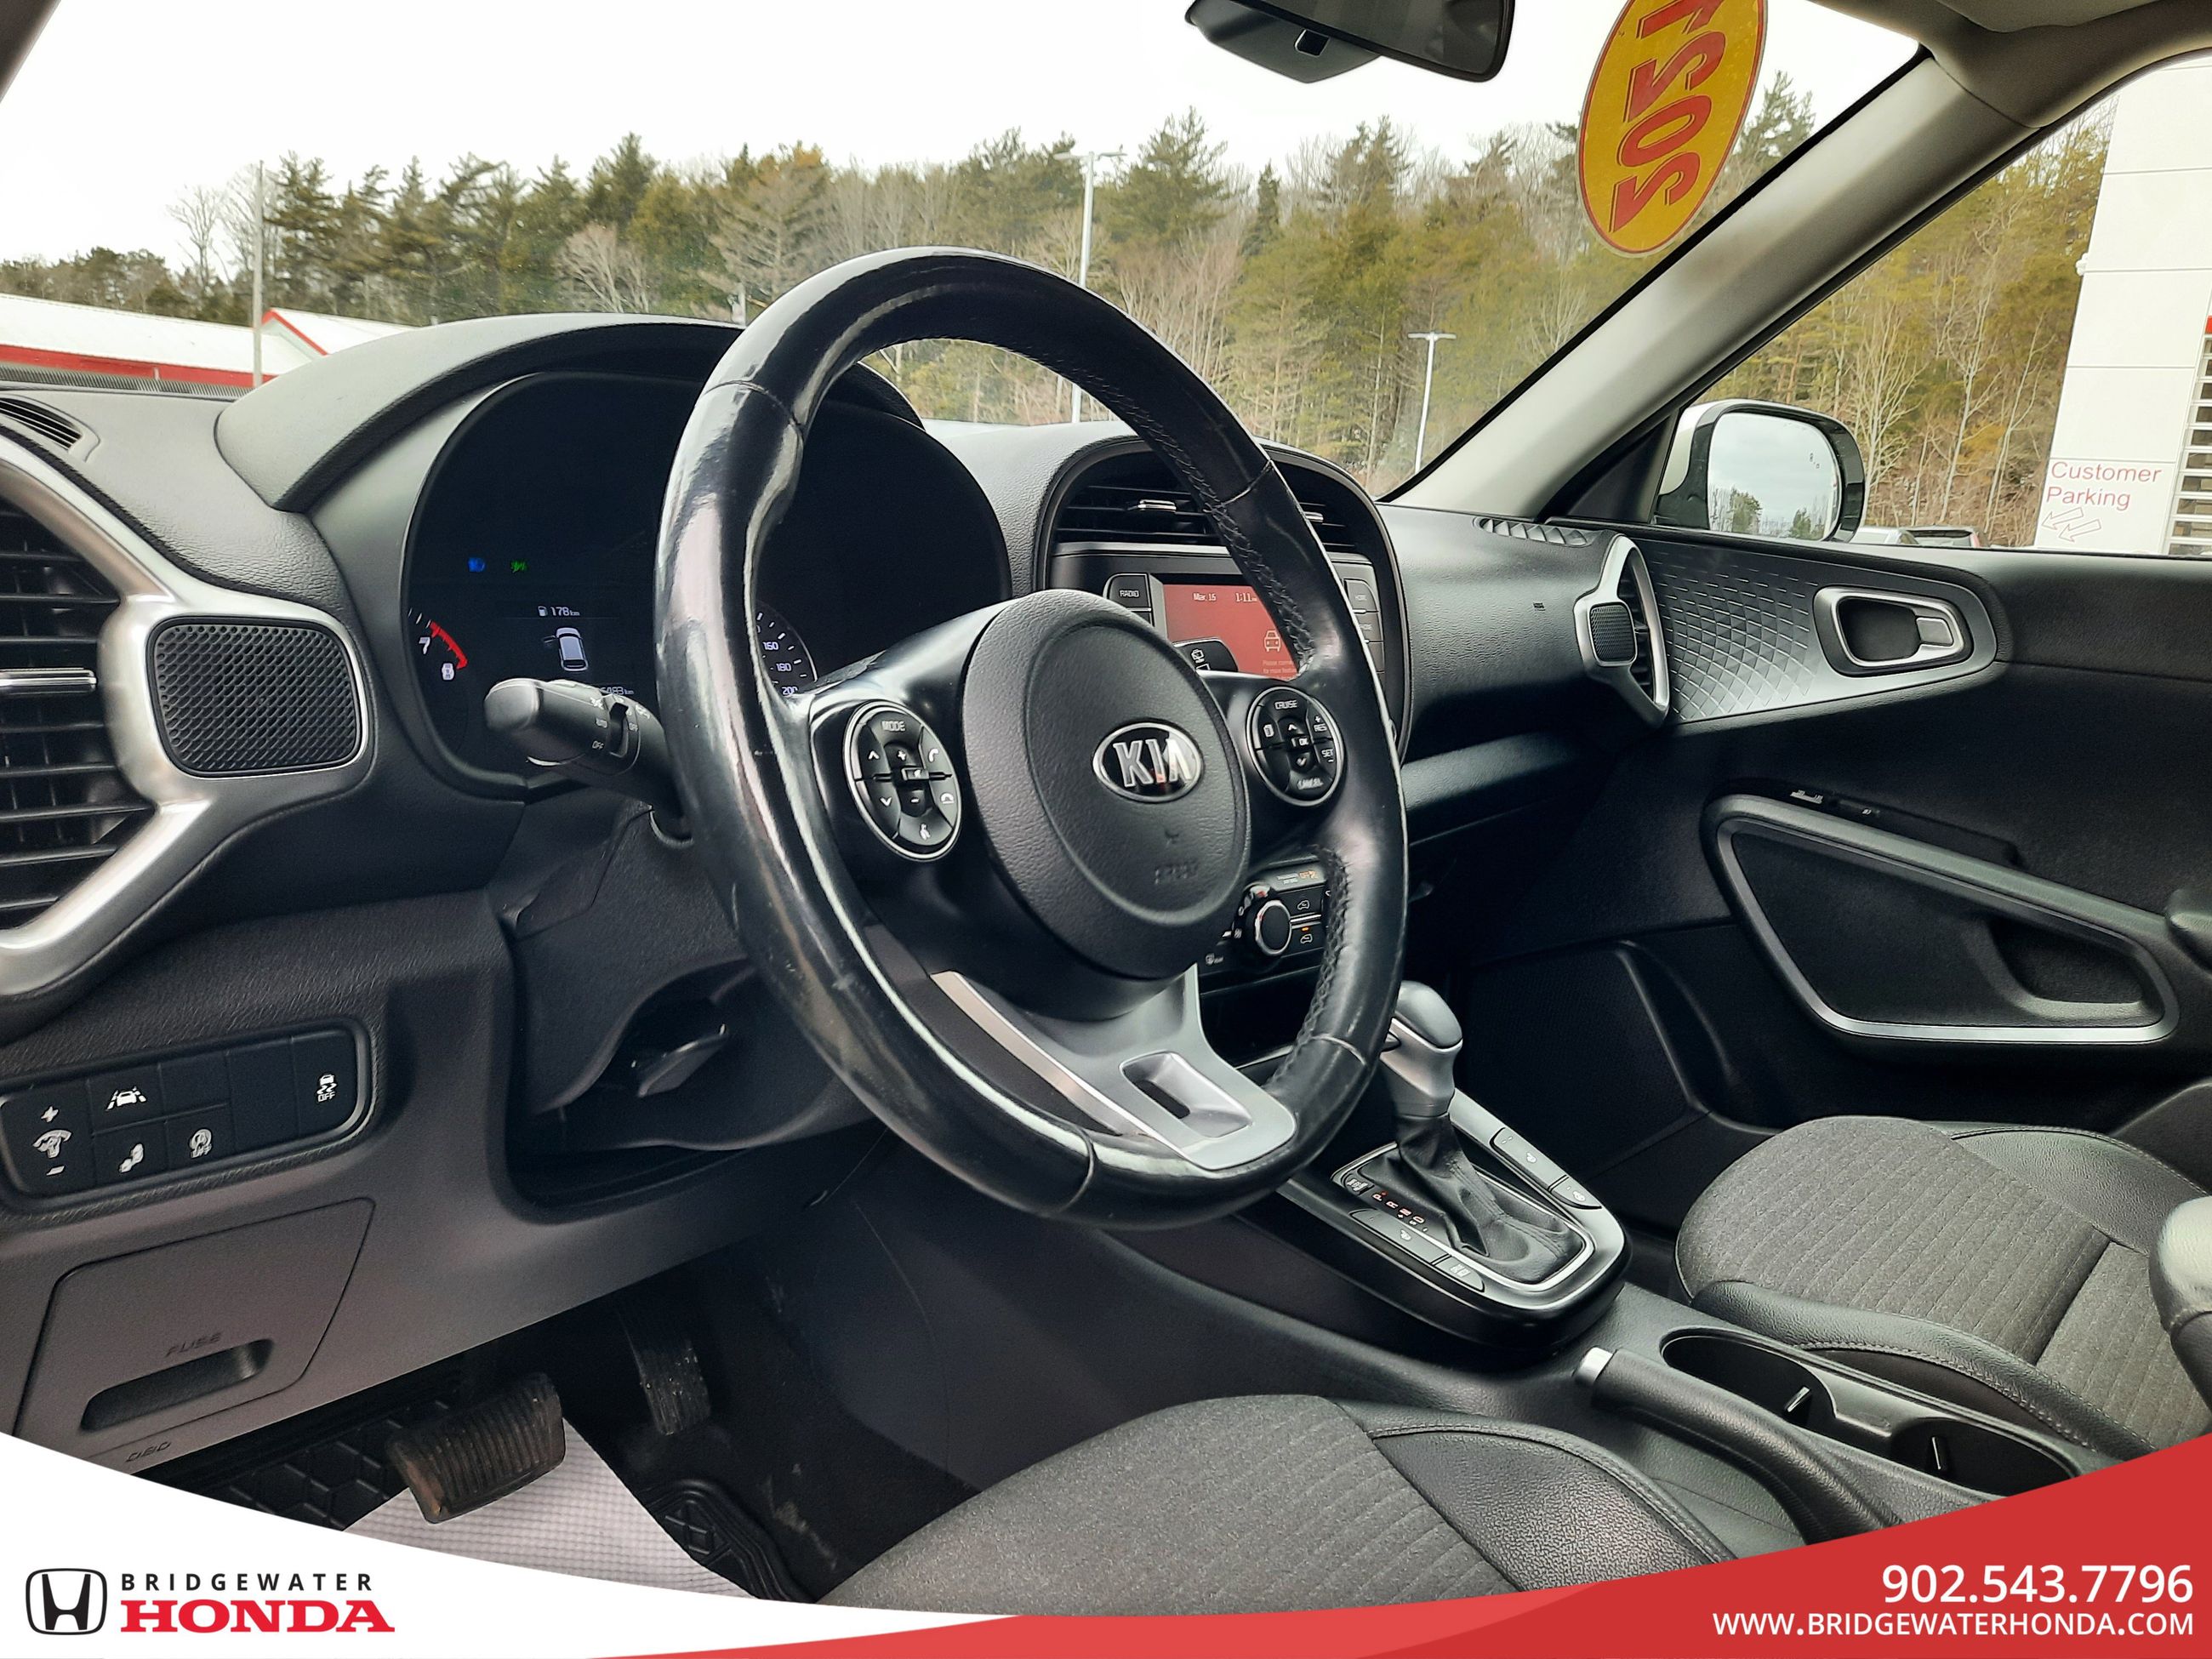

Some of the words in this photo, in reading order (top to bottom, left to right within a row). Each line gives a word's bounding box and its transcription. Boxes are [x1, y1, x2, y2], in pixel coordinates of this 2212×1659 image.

[2050, 461, 2162, 482] Customer
[2046, 486, 2131, 510] Parking
[881, 721, 906, 732] MODE
[1112, 738, 1192, 788] KIA
[317, 1091, 336, 1103] OFF
[166, 1331, 223, 1358] FUSE
